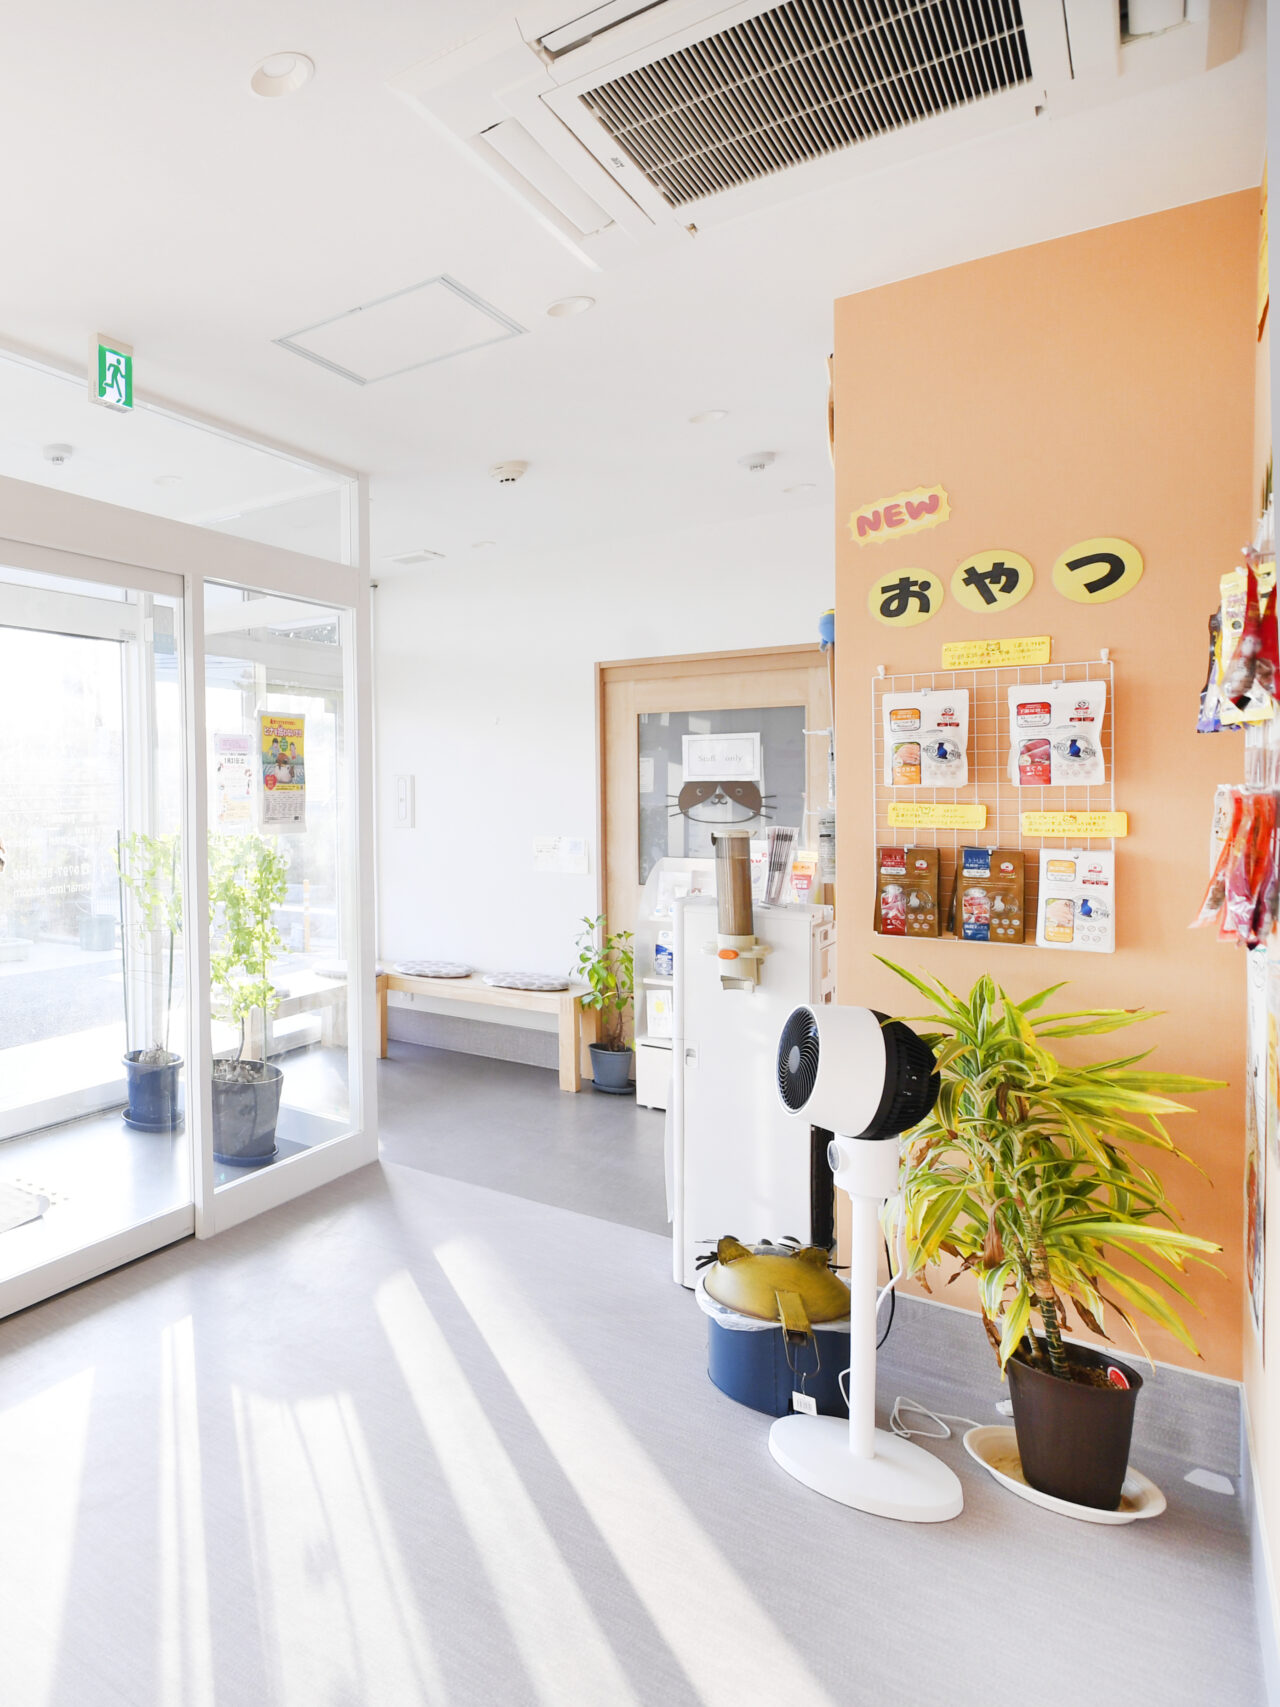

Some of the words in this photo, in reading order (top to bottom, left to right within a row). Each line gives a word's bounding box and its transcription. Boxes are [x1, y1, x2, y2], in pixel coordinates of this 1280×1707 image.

[856, 494, 940, 537] NEW
[880, 552, 1126, 618] おやつ
[725, 753, 743, 764] only
